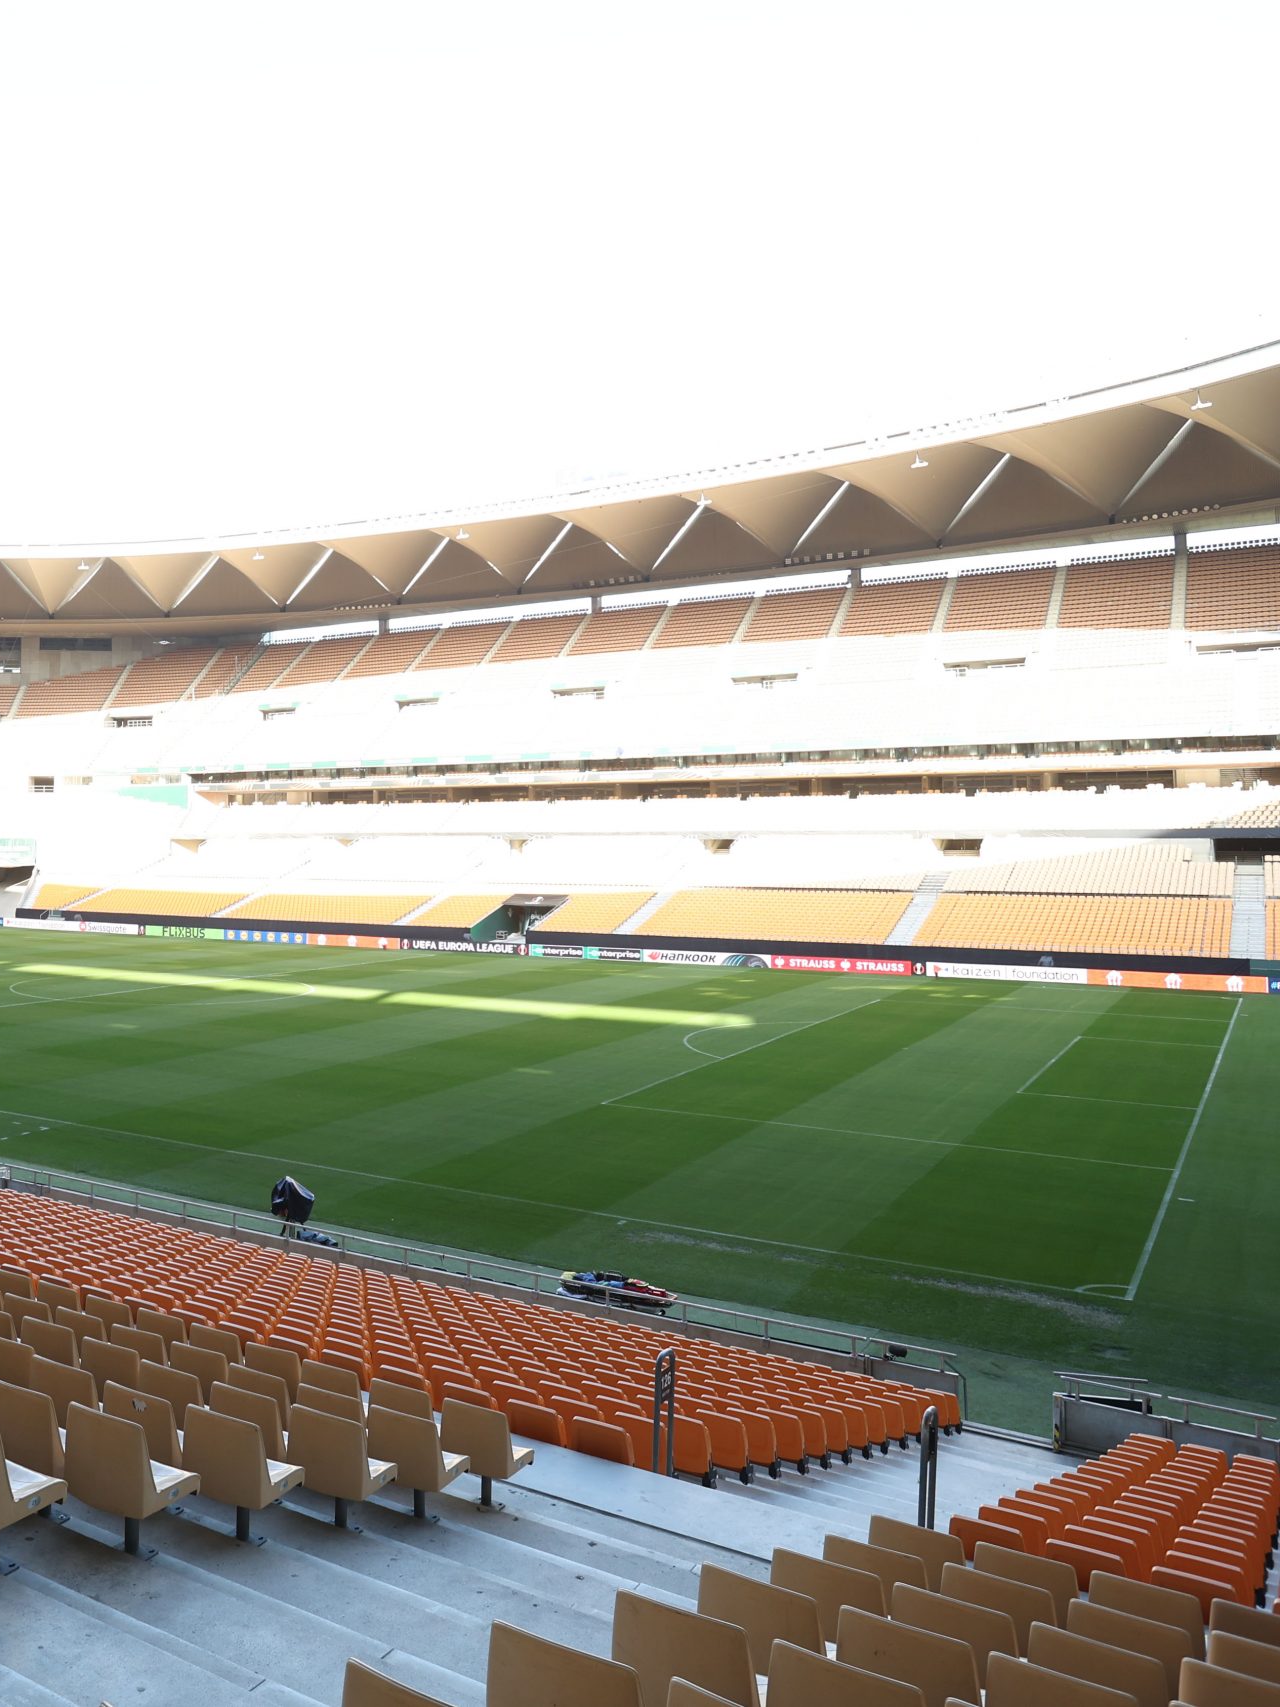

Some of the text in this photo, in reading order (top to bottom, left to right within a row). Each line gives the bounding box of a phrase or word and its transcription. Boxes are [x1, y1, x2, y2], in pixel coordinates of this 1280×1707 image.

[87, 922, 127, 933] Swissquote
[412, 940, 514, 953] UEFA EUROPA LEAGUE
[540, 947, 641, 960] enterprise enterprise
[789, 958, 904, 972] STRAUSS STRAUSS
[952, 965, 1079, 981] kaizen foundation
[661, 1371, 671, 1390] 126
